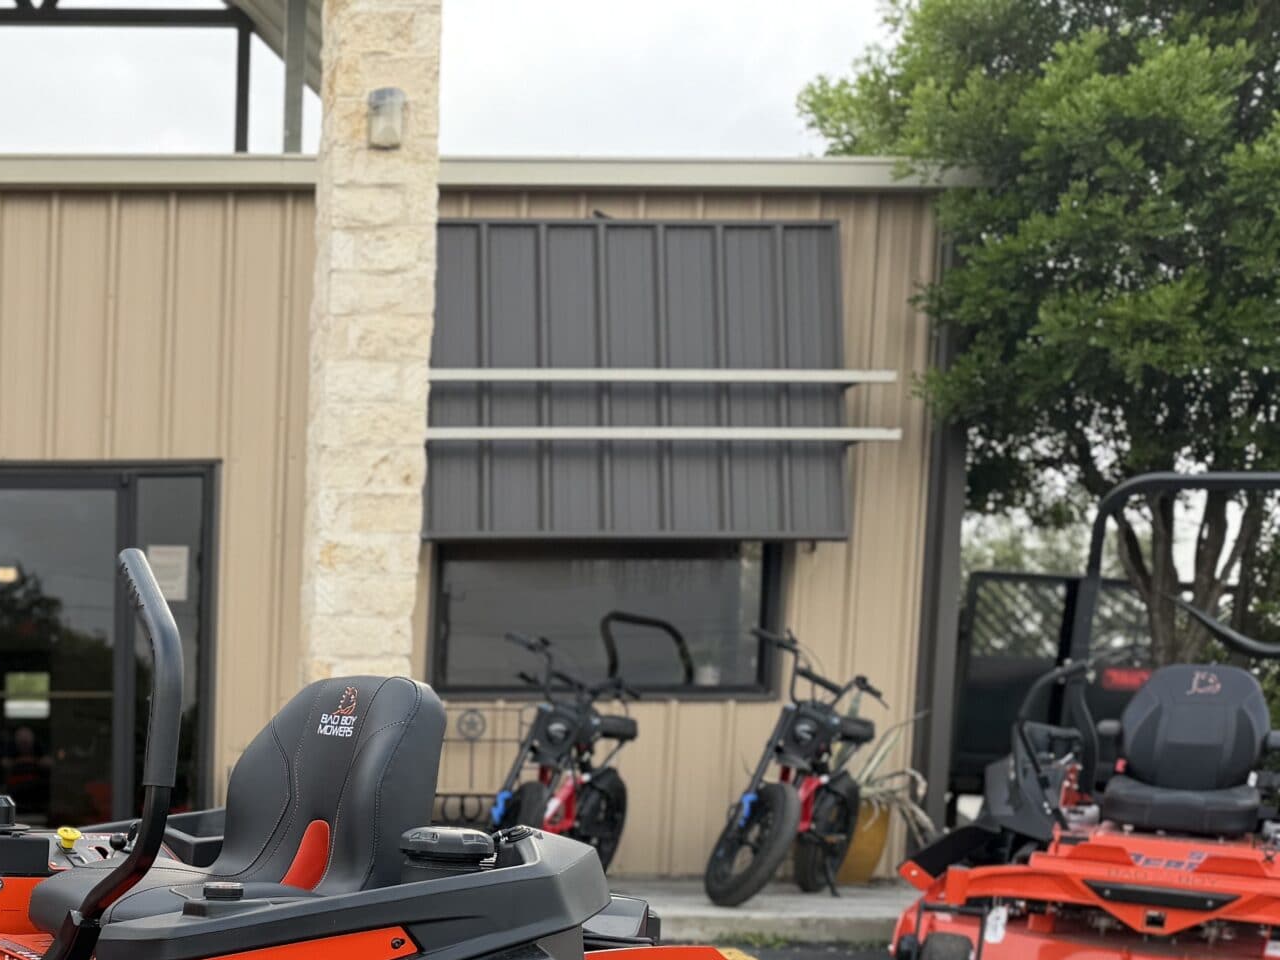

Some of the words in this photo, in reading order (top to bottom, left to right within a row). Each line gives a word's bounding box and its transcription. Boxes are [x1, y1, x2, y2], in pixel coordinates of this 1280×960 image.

[321, 714, 340, 725] BAD
[340, 715, 358, 726] BOY
[317, 724, 354, 737] MOWERS
